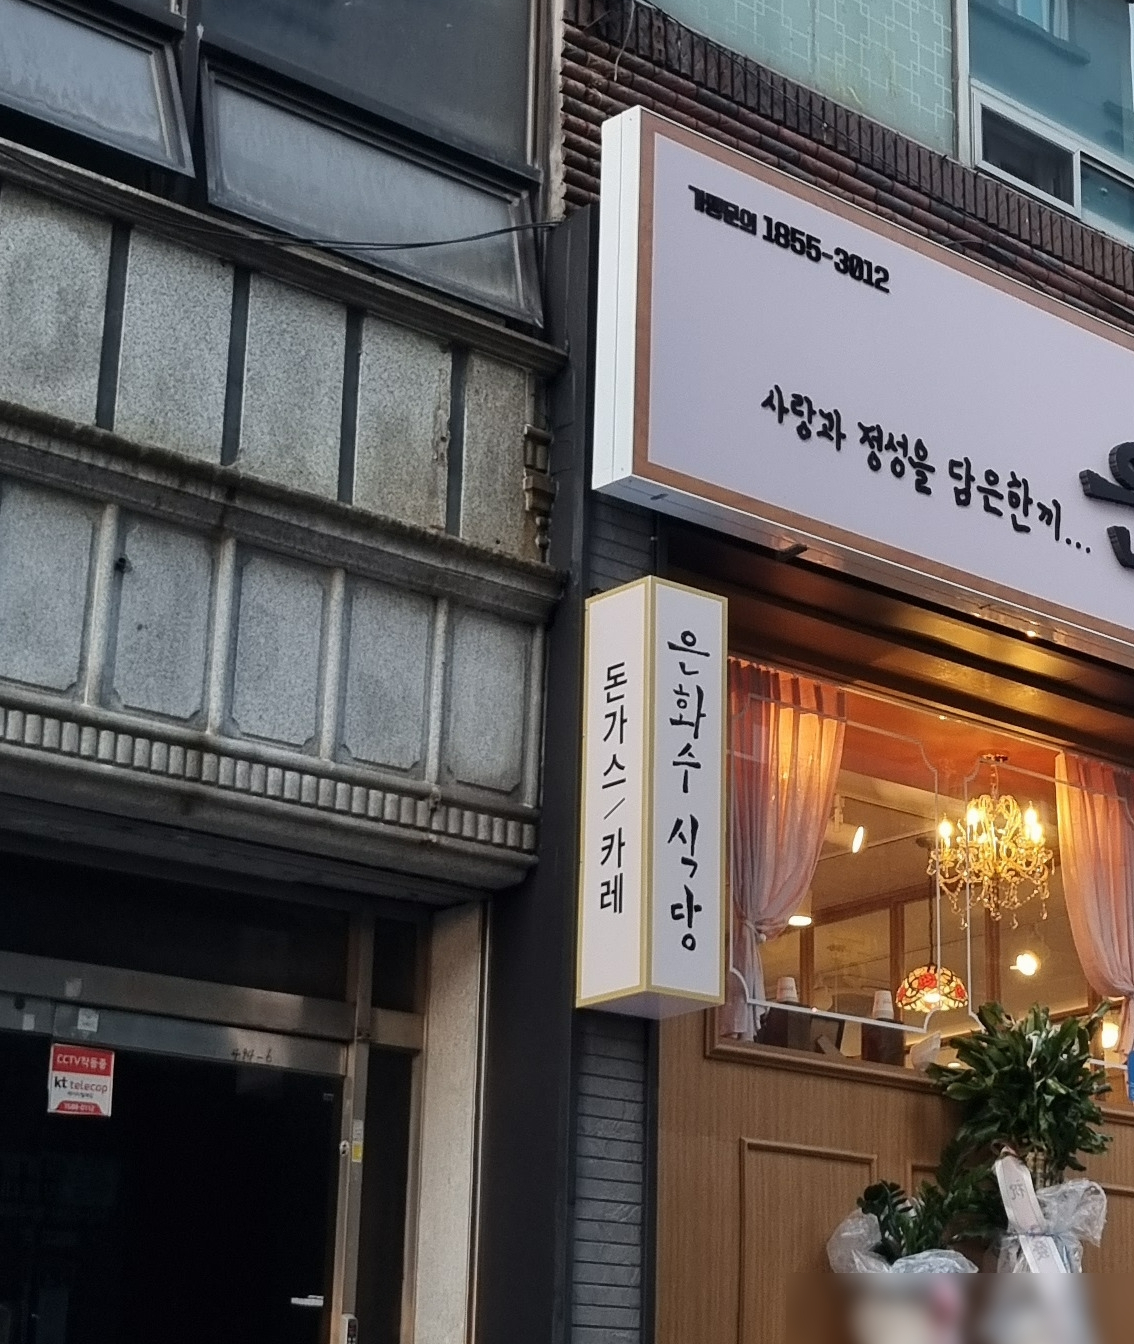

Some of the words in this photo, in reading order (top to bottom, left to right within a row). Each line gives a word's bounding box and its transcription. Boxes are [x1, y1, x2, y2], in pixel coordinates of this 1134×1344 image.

[762, 214, 890, 294] 1855-3012
[761, 384, 846, 452] 사랑과
[858, 421, 936, 496] 정성을
[666, 629, 711, 794] 은화수
[667, 813, 702, 952] 식당
[54, 1076, 68, 1089] kt
[70, 1079, 108, 1093] telecop
